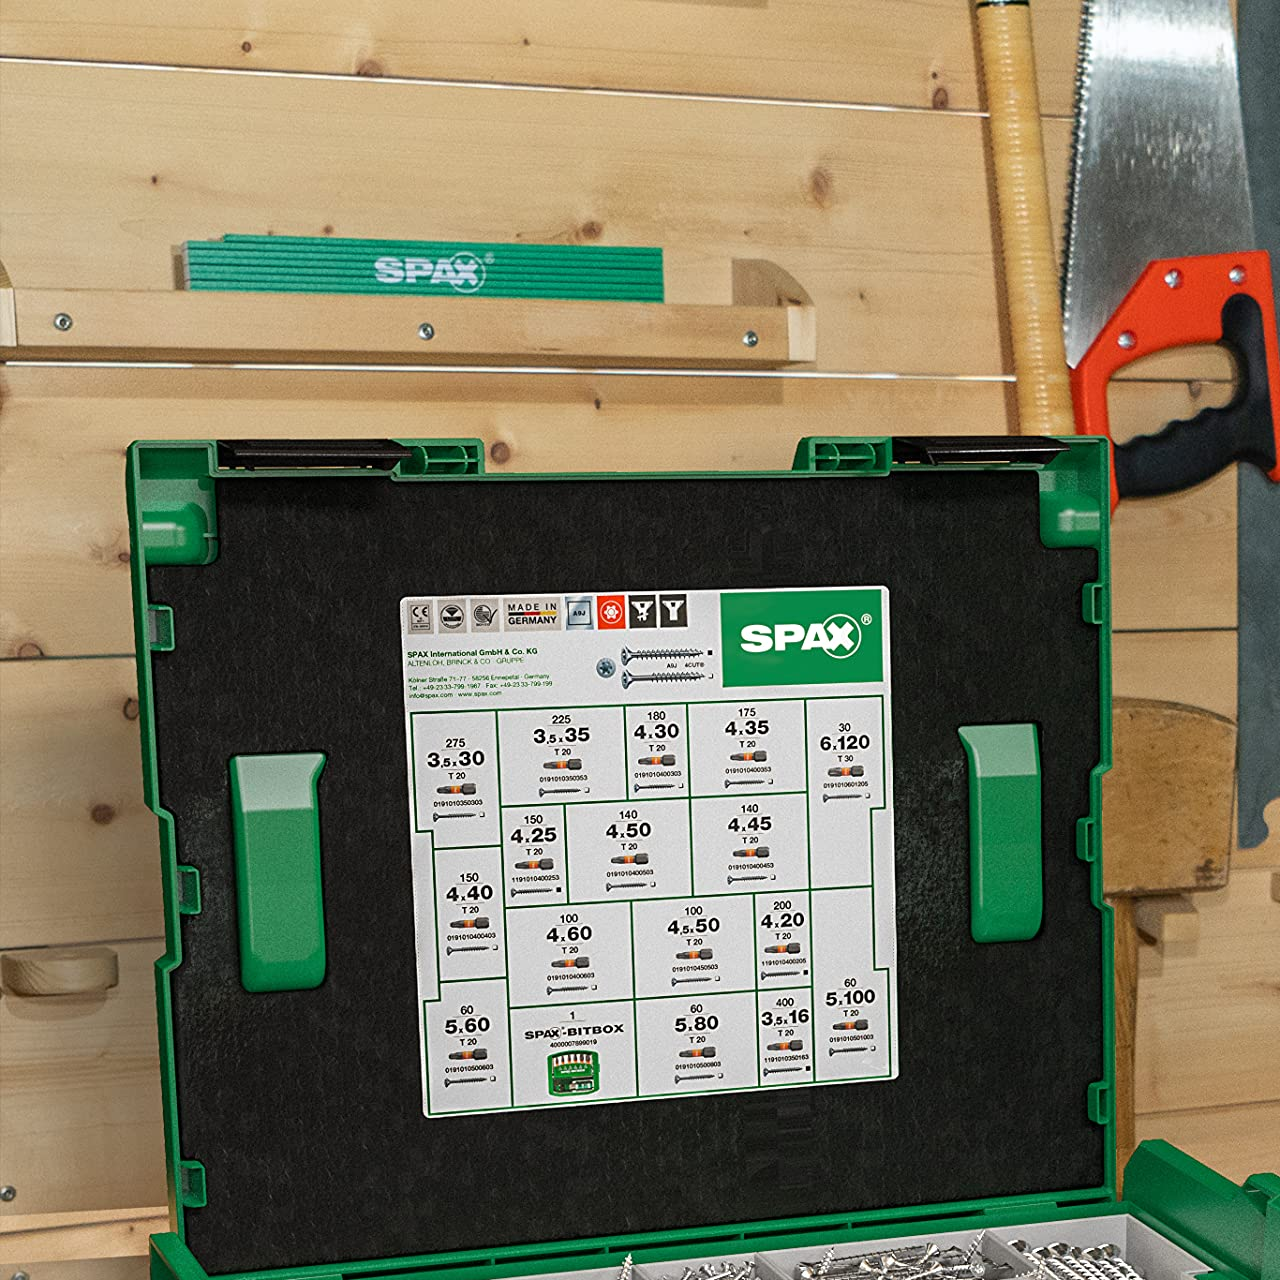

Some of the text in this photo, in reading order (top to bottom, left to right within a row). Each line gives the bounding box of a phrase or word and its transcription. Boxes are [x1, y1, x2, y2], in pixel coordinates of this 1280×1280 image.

[373, 256, 479, 288] SPAX
[508, 602, 557, 611] MADE IN
[508, 616, 557, 625] GERMANY
[740, 621, 855, 653] SPAX
[430, 649, 478, 658] International
[479, 648, 503, 656] GmbH
[526, 647, 538, 655] KG
[647, 711, 666, 721] 180
[738, 708, 756, 717] 175
[551, 715, 572, 725] 225
[838, 723, 851, 732] 30
[445, 738, 466, 748] 275
[746, 740, 756, 748] 20
[554, 748, 572, 756] T 20
[649, 744, 666, 752] T 20
[448, 771, 466, 780] T 20
[741, 804, 759, 814] 140
[524, 814, 543, 824] 150
[619, 810, 638, 820] 140
[748, 836, 759, 844] 20
[620, 842, 638, 851] T 20
[526, 847, 544, 856] T 20
[459, 872, 480, 883] 150
[461, 905, 480, 914] T 20
[773, 901, 792, 910] 200
[684, 906, 703, 915] 100
[560, 913, 579, 923] 100
[781, 932, 792, 940] 20
[686, 938, 692, 946] T
[561, 946, 579, 954] T 20
[844, 978, 857, 988] 60
[775, 998, 795, 1007] 400
[460, 1005, 474, 1015] 60
[690, 1004, 703, 1014] 60
[843, 1009, 860, 1017] T 20
[570, 1011, 576, 1020] 1
[778, 1029, 795, 1037] T 20
[466, 1038, 477, 1046] 20
[695, 1035, 706, 1043] 20
